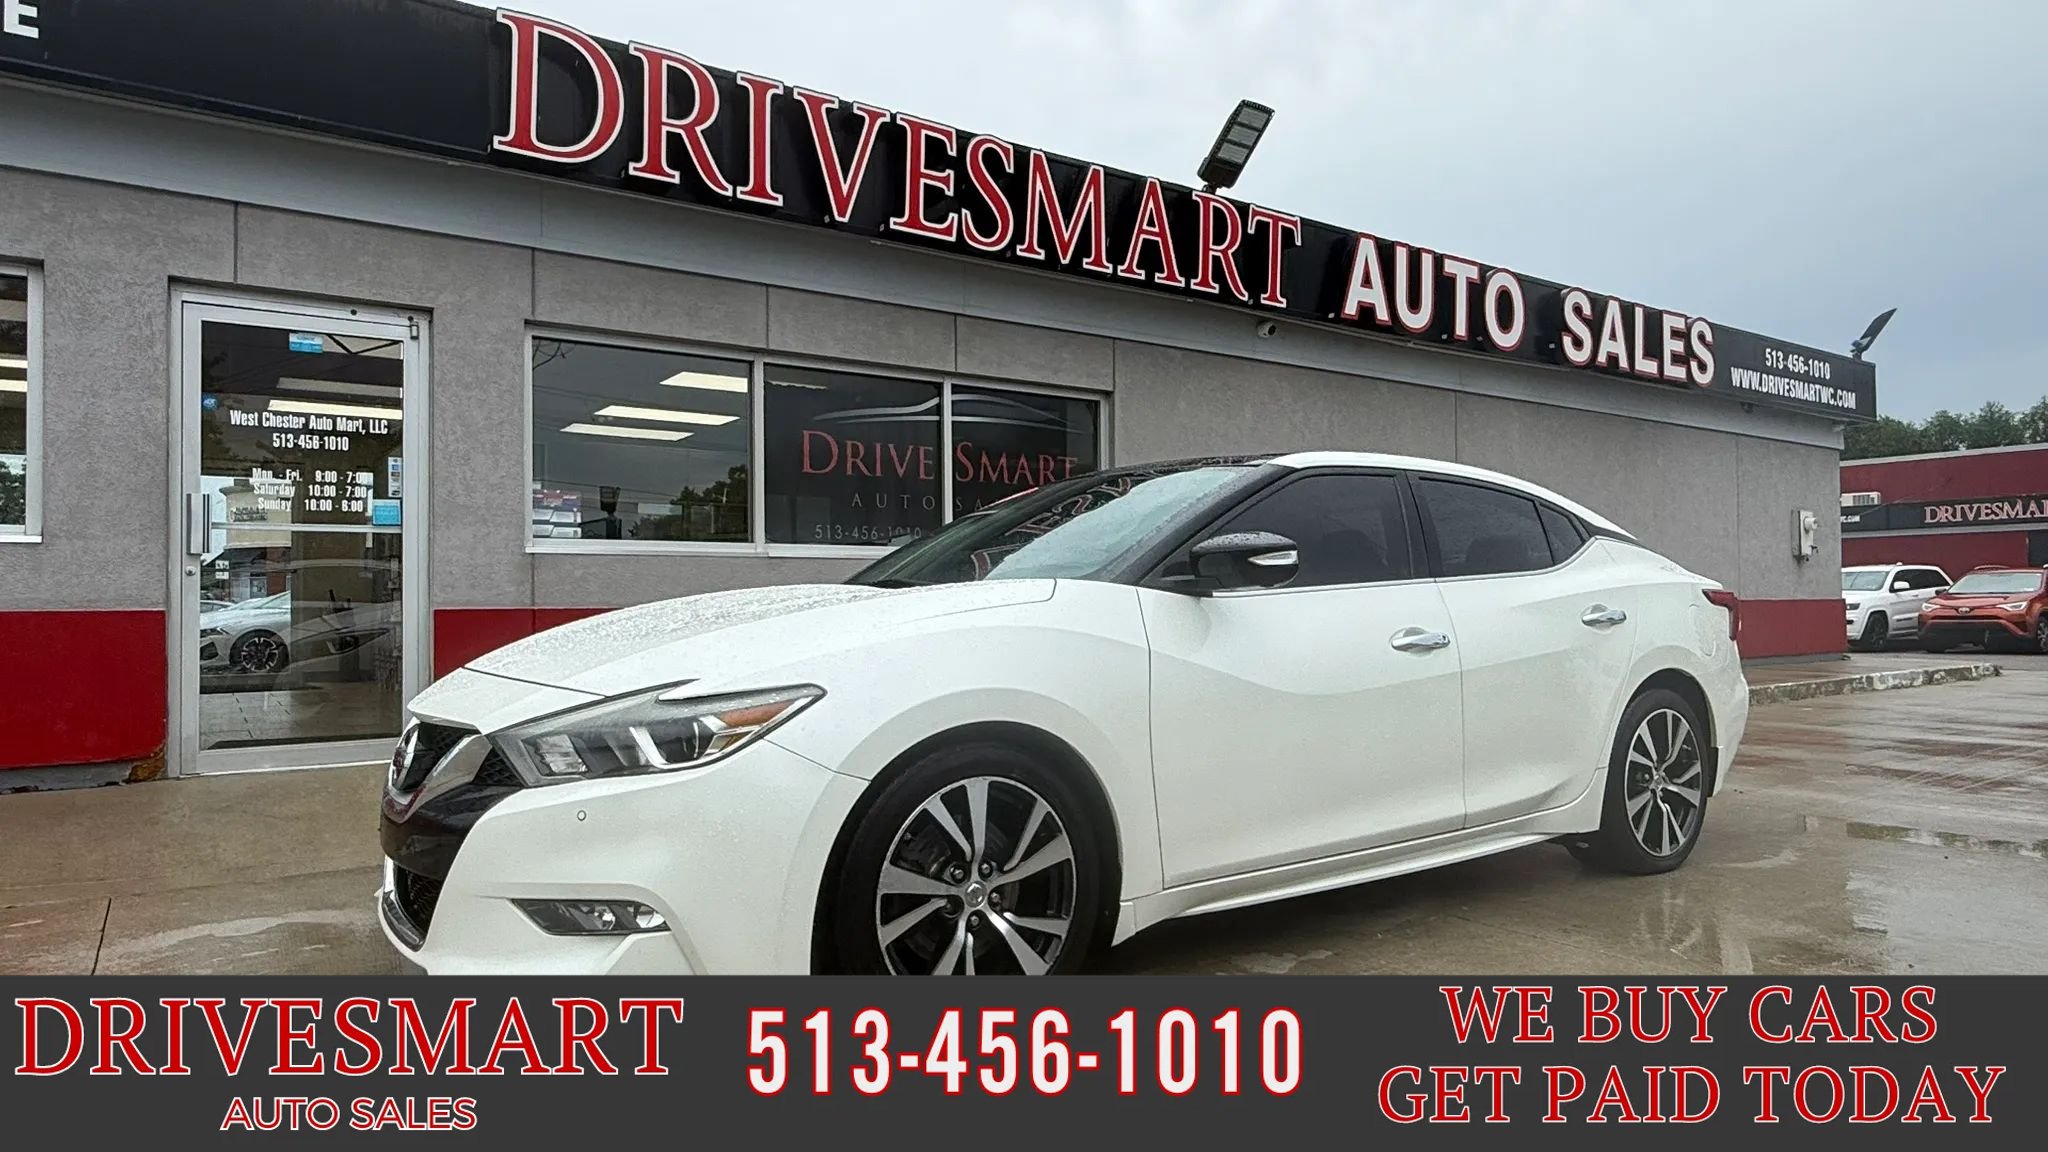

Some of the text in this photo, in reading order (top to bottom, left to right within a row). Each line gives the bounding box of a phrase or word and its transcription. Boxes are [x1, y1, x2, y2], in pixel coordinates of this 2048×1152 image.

[493, 8, 1716, 387] DRIVESMART AUTO SALES
[1765, 348, 1830, 380] 513-456-1010
[1731, 366, 1856, 409] WWW.DRIVESMARTWC.COM
[230, 410, 388, 435] West Chester Auto Mart, LLC
[272, 433, 349, 451] 513-456-1010
[802, 430, 935, 480] DRIVE
[315, 470, 338, 483] 9:00
[253, 483, 296, 497] Saturday
[308, 485, 336, 497] 10:00
[345, 486, 367, 498] 7:00
[258, 497, 292, 512] Sunday
[304, 499, 332, 511] 10:00
[851, 493, 936, 512] AUTO
